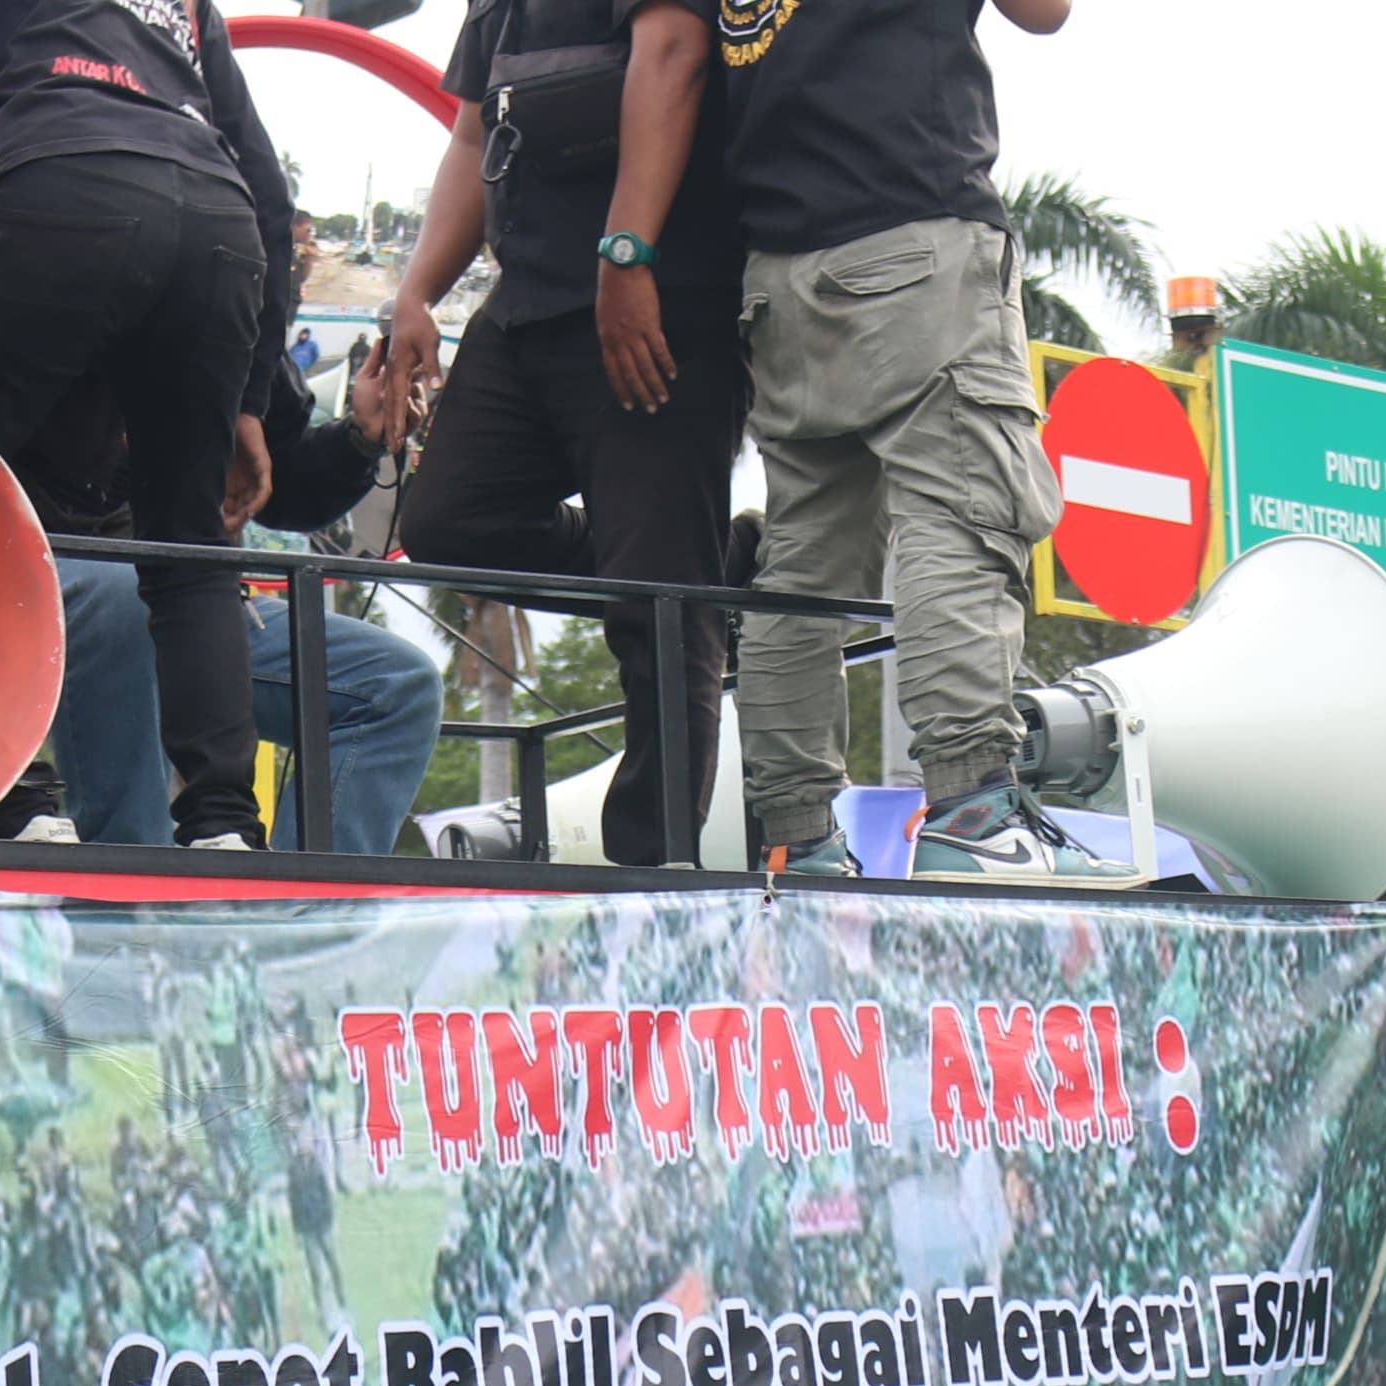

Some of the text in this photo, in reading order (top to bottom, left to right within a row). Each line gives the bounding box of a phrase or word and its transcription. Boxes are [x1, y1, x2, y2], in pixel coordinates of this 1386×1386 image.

[1325, 450, 1380, 490] PINTU
[1250, 493, 1381, 547] KEMENTERIAN
[340, 1002, 891, 1178] TUNTUTAN
[928, 1003, 1134, 1156] AKSI
[1211, 1267, 1332, 1376] ESDM
